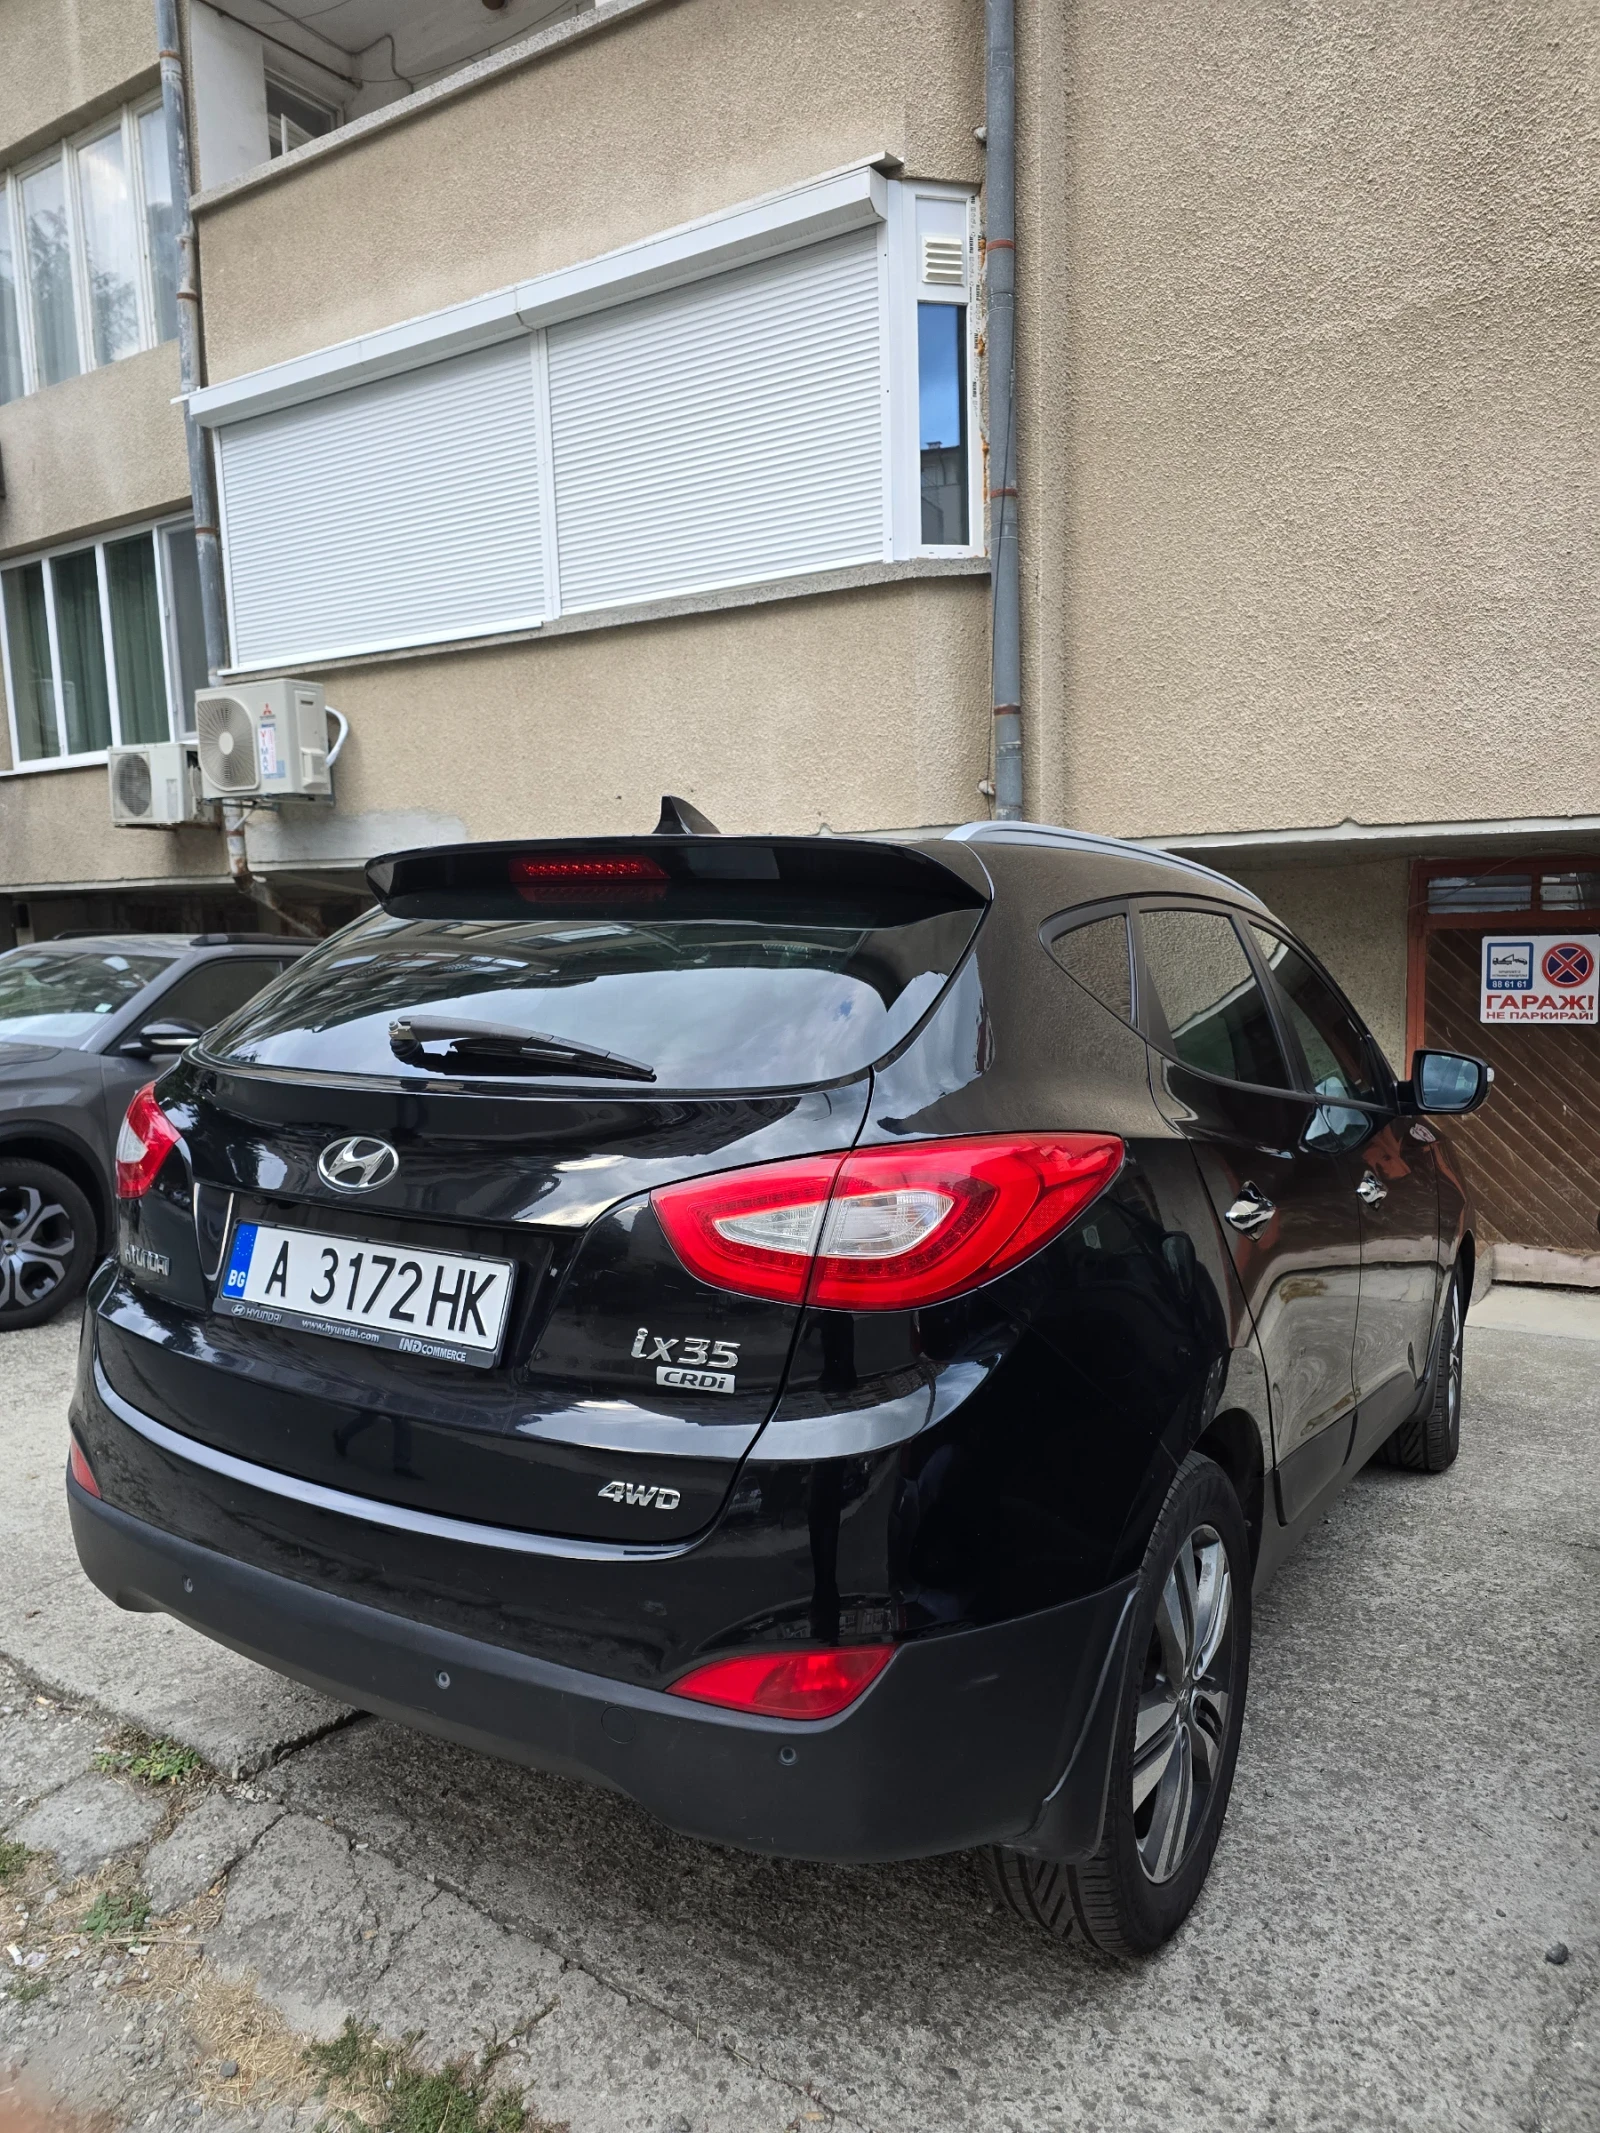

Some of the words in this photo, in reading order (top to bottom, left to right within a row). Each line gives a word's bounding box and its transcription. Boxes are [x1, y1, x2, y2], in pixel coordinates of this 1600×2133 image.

[1486, 995, 1595, 1010] ГАРАЖ!
[1486, 1011, 1505, 1020] НЕ
[1510, 1010, 1594, 1021] ПАРКИРАЙ!
[227, 1269, 246, 1288] BG
[264, 1240, 290, 1298] A
[246, 1307, 283, 1323] HYUNDAI
[301, 1319, 380, 1343] www.hyundai.com
[630, 1327, 741, 1369] ix35
[663, 1371, 727, 1390] CRDi
[597, 1480, 681, 1510] 4WD
